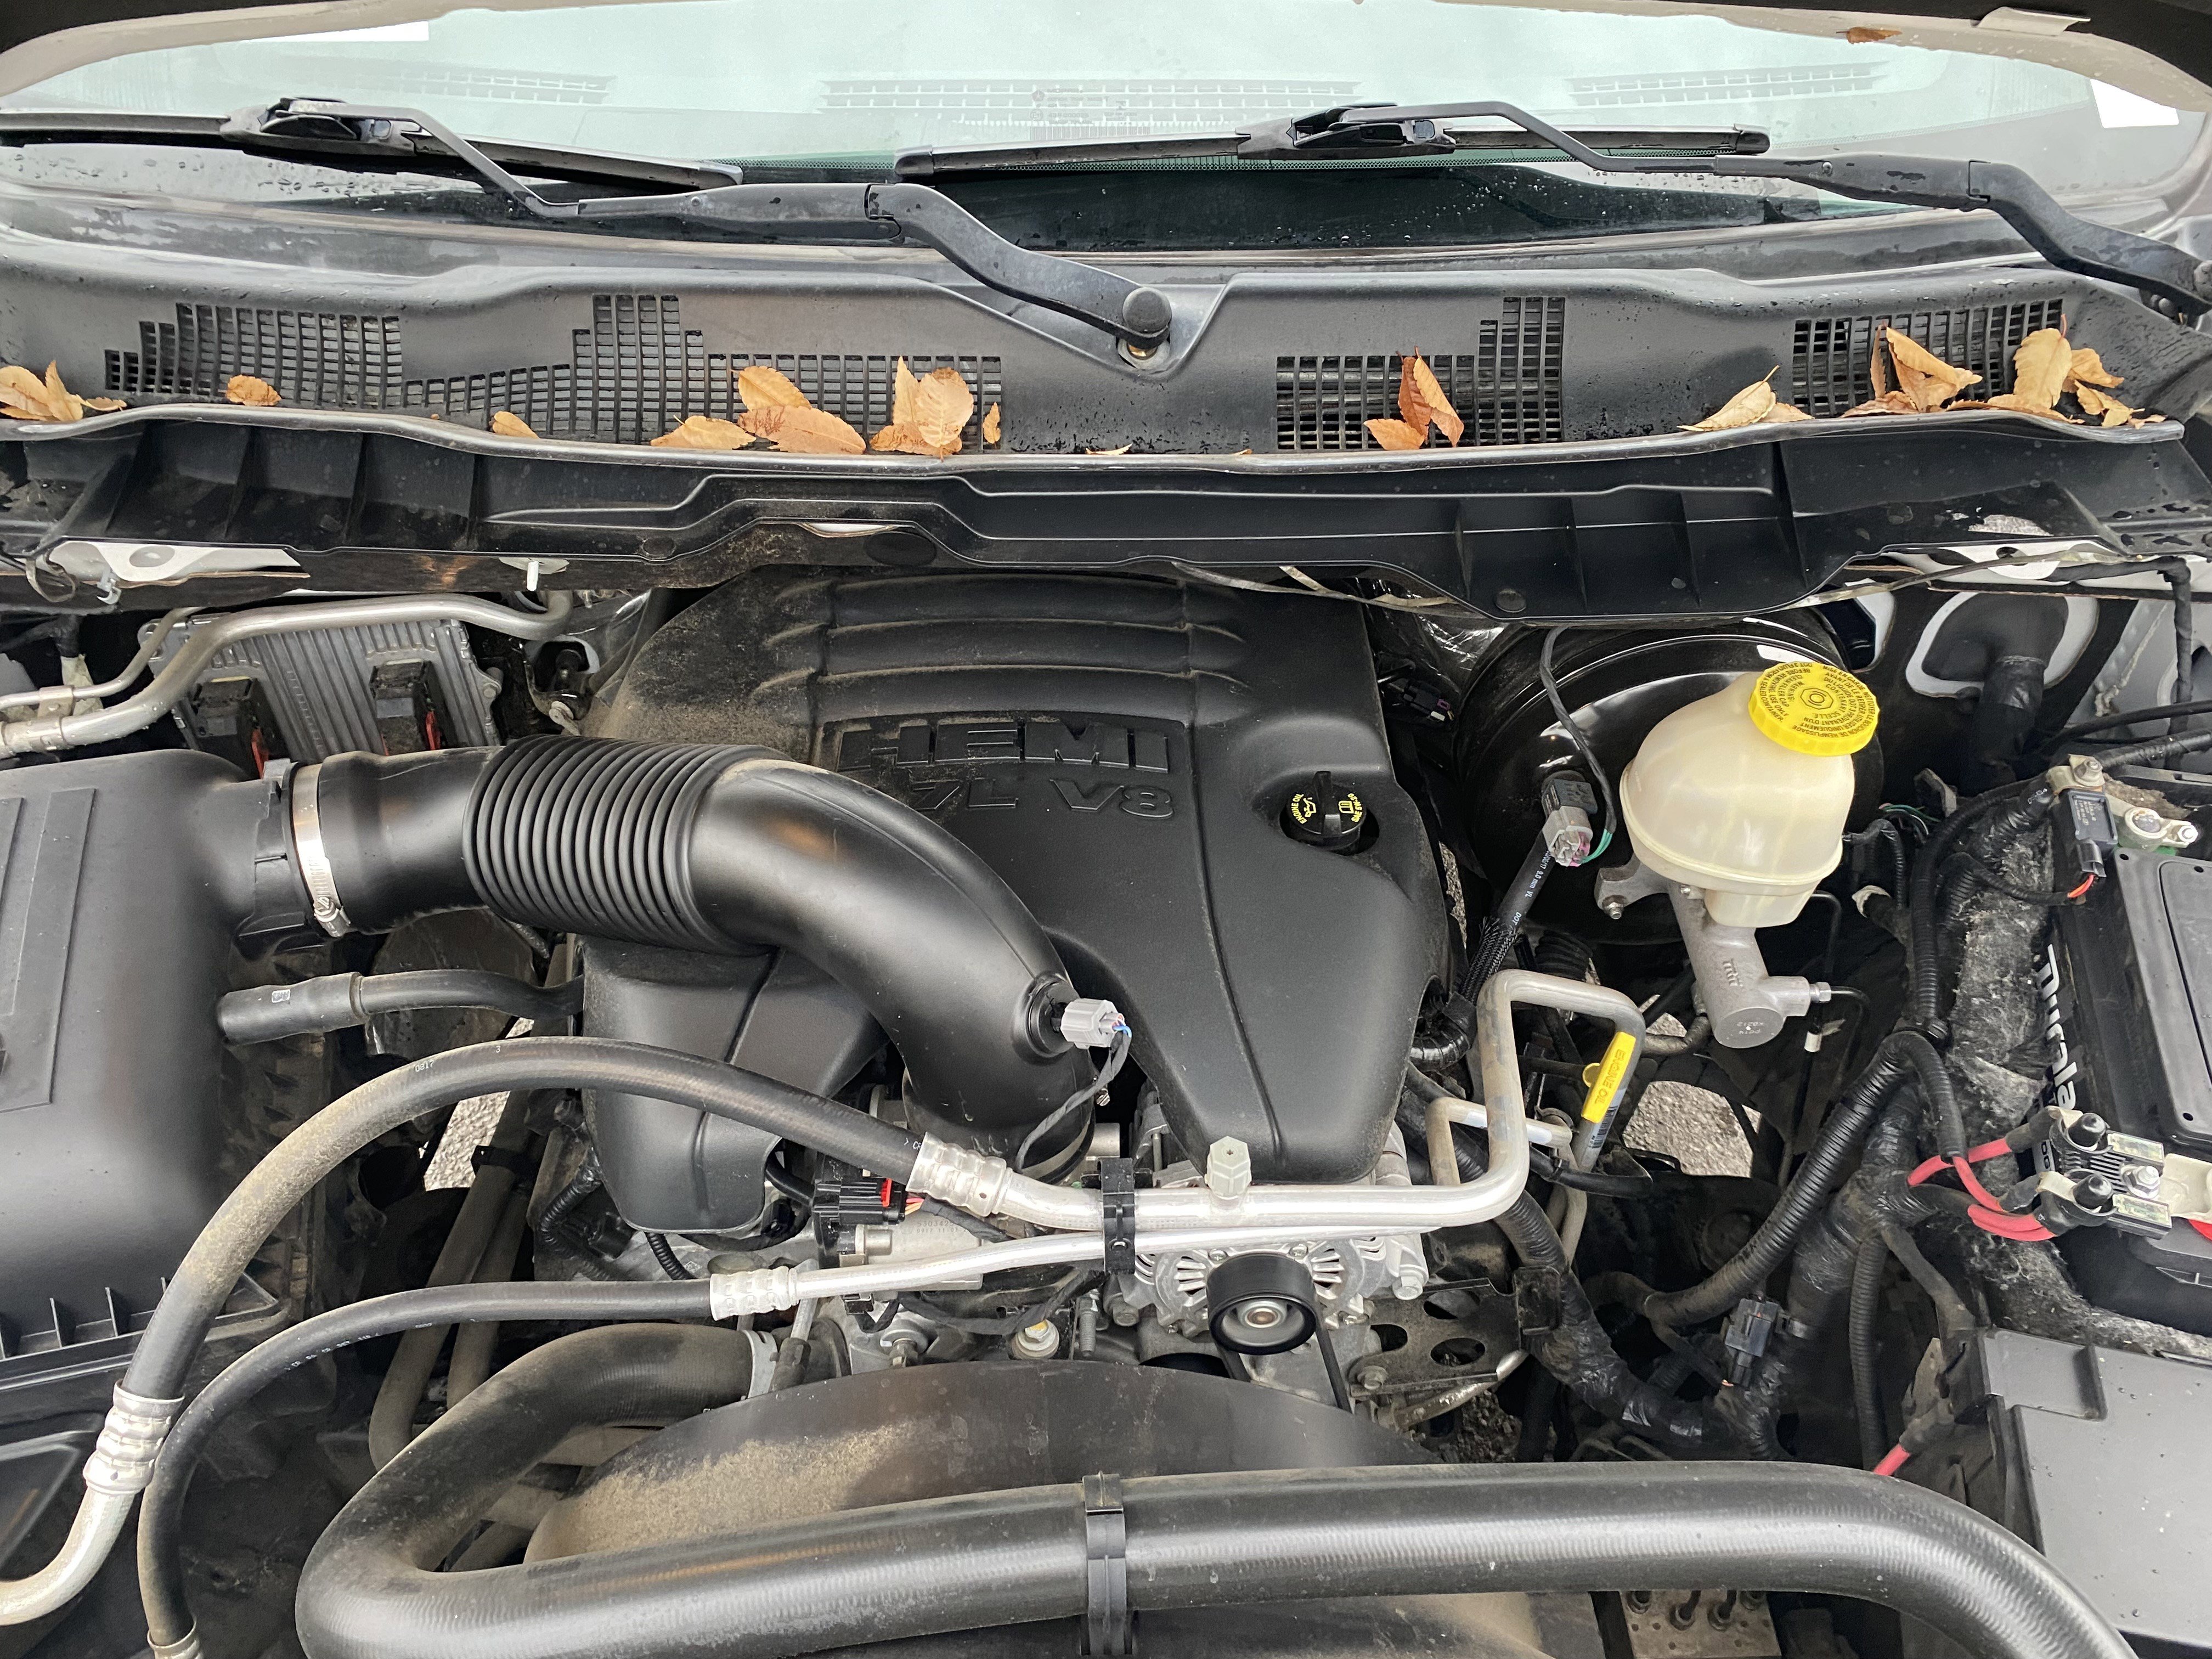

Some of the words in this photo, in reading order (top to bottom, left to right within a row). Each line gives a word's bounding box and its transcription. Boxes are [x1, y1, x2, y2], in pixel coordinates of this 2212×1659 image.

[1785, 675, 1803, 684] CLEAN
[1825, 672, 1847, 682] AVANT
[1778, 682, 1788, 697] FILLER
[1833, 681, 1854, 698] LIQUIDE
[1769, 695, 1778, 703] USE
[1774, 705, 1789, 716] ONLY
[1779, 697, 1789, 707] CAP
[1826, 684, 1847, 713] CONTENANT
[1792, 725, 1838, 738] REMPLISSAGE
[1800, 723, 1844, 731] UNIQUEMENT
[837, 719, 1169, 774] HEMI
[910, 777, 1019, 811] 7L
[1049, 777, 1173, 819] V8
[1292, 793, 1305, 803] OIL
[1347, 792, 1363, 811] 5W-20
[1291, 802, 1308, 825] ENGINE
[1351, 811, 1363, 823] SAE
[1512, 911, 1522, 926] DOT
[414, 1059, 435, 1073] 0817
[495, 1045, 501, 1053] 3
[1602, 1048, 1627, 1089] ENGINE
[1594, 1088, 1609, 1105] OIL
